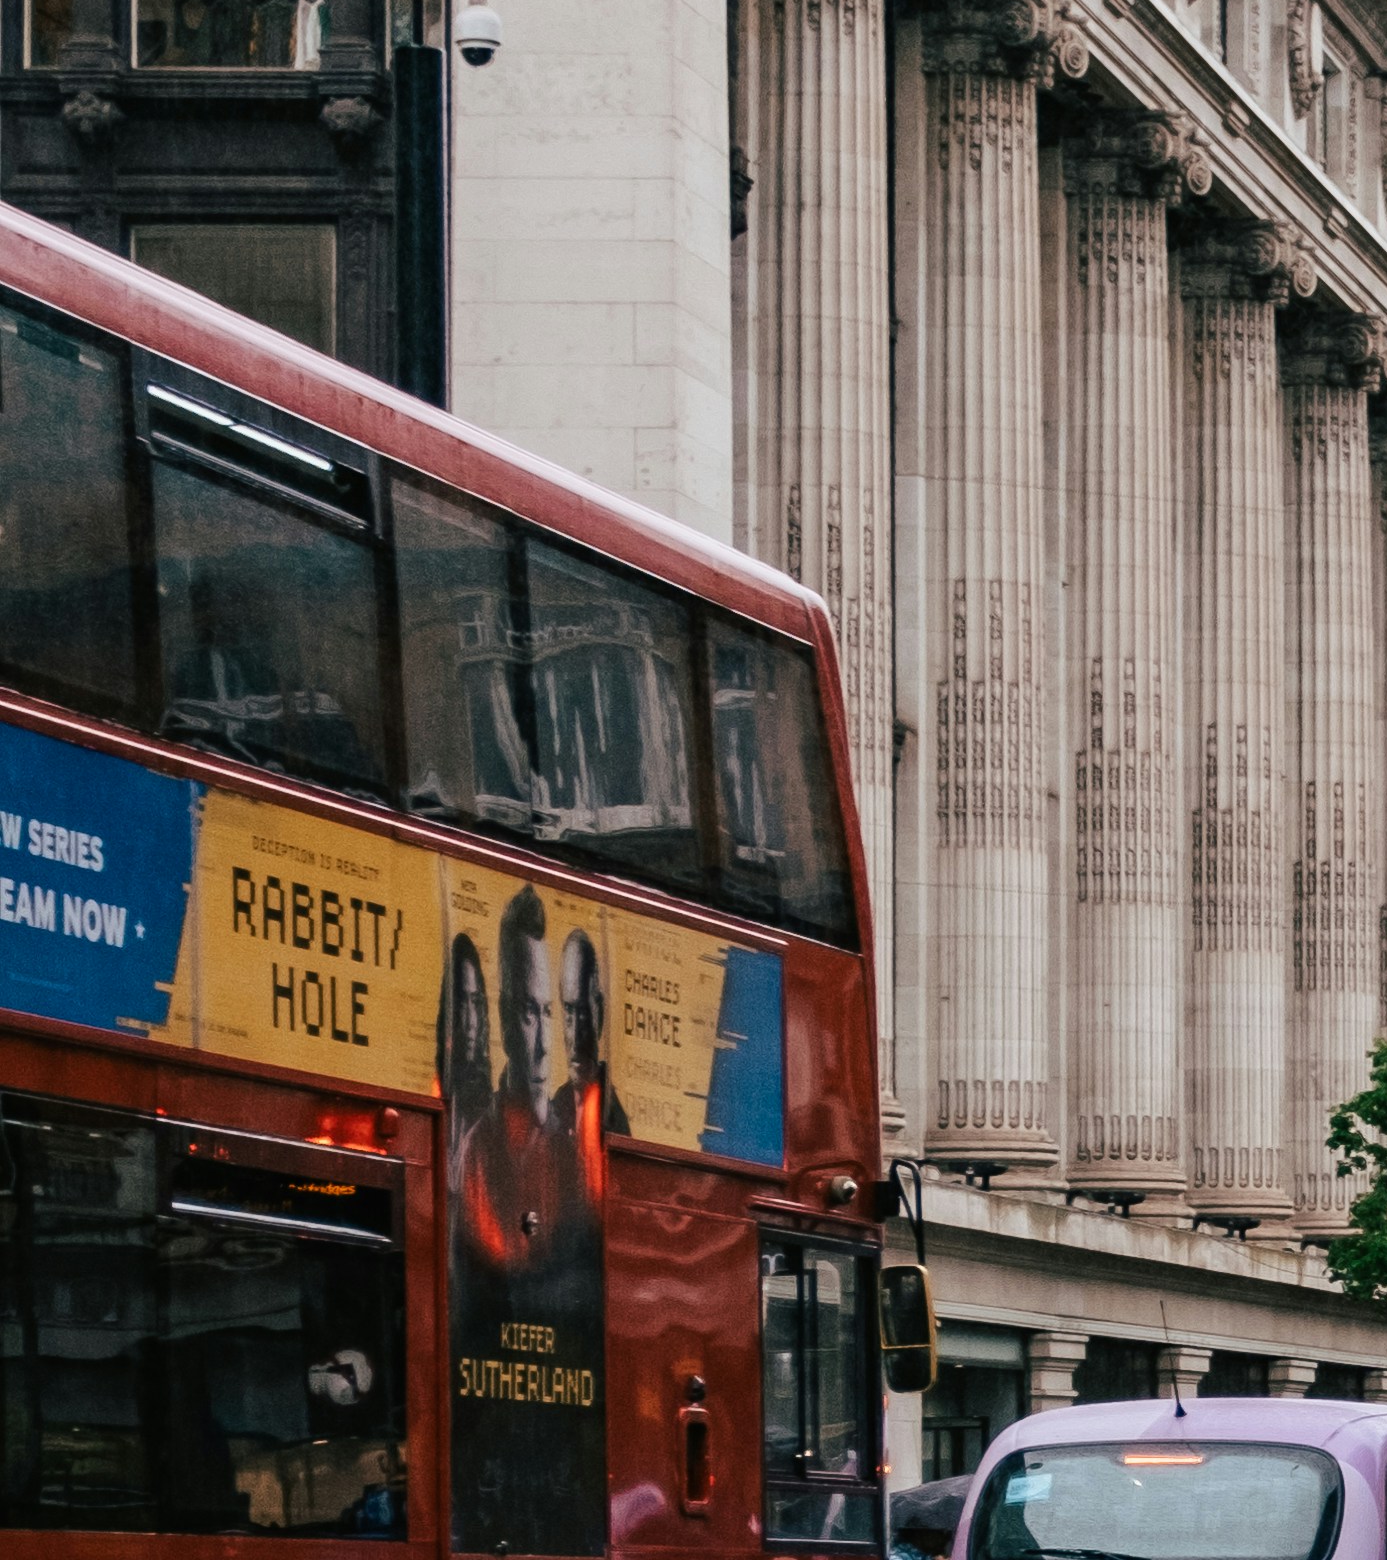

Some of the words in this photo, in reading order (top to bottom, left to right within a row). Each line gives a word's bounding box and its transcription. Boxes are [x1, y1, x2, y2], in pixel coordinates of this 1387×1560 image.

[28, 818, 104, 872] SERIES
[320, 853, 332, 870] IS
[63, 893, 127, 948] NOW
[272, 963, 369, 1047] HOLE
[624, 969, 681, 1006] CHARLES
[624, 1003, 682, 1048] DANCE
[501, 1322, 555, 1354] KIEFER
[459, 1358, 594, 1407] SUTHERLAND
